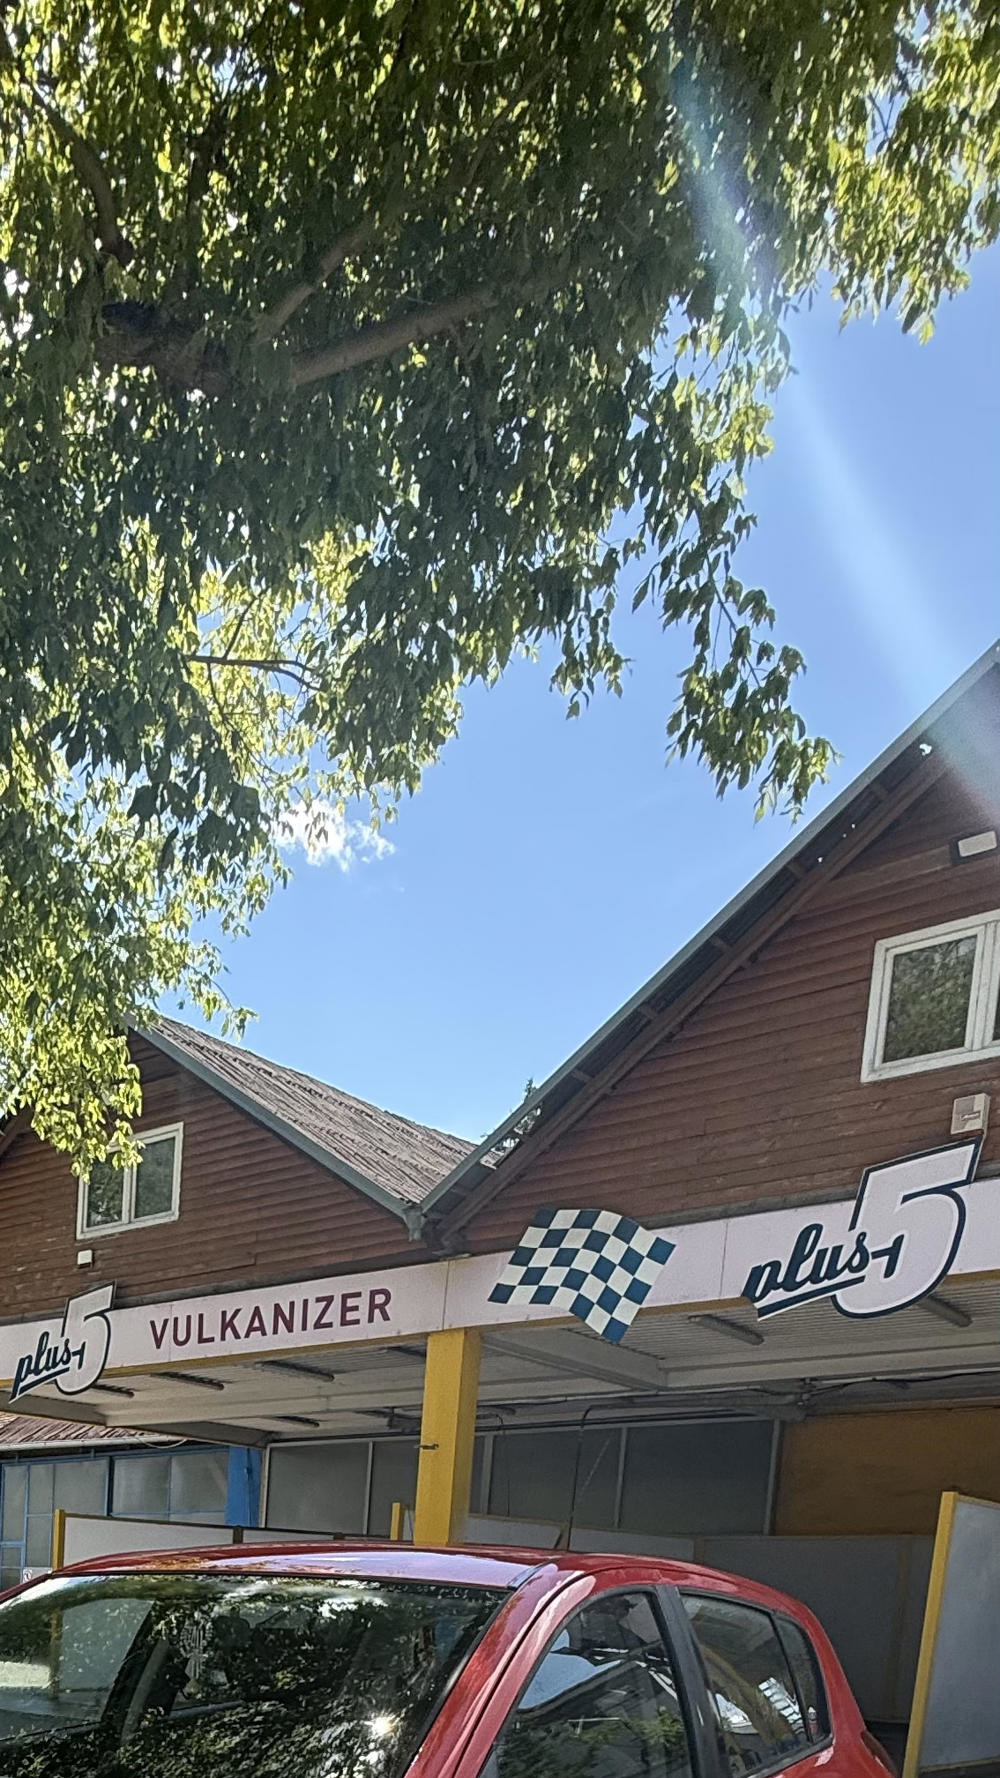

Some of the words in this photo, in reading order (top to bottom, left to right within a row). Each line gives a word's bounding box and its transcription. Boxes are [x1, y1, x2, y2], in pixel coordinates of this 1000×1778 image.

[742, 1223, 870, 1300] plus
[829, 1136, 983, 1319] 5
[14, 1331, 71, 1388] plus
[55, 1281, 117, 1395] 5
[148, 1288, 392, 1350] VULKANIZER
